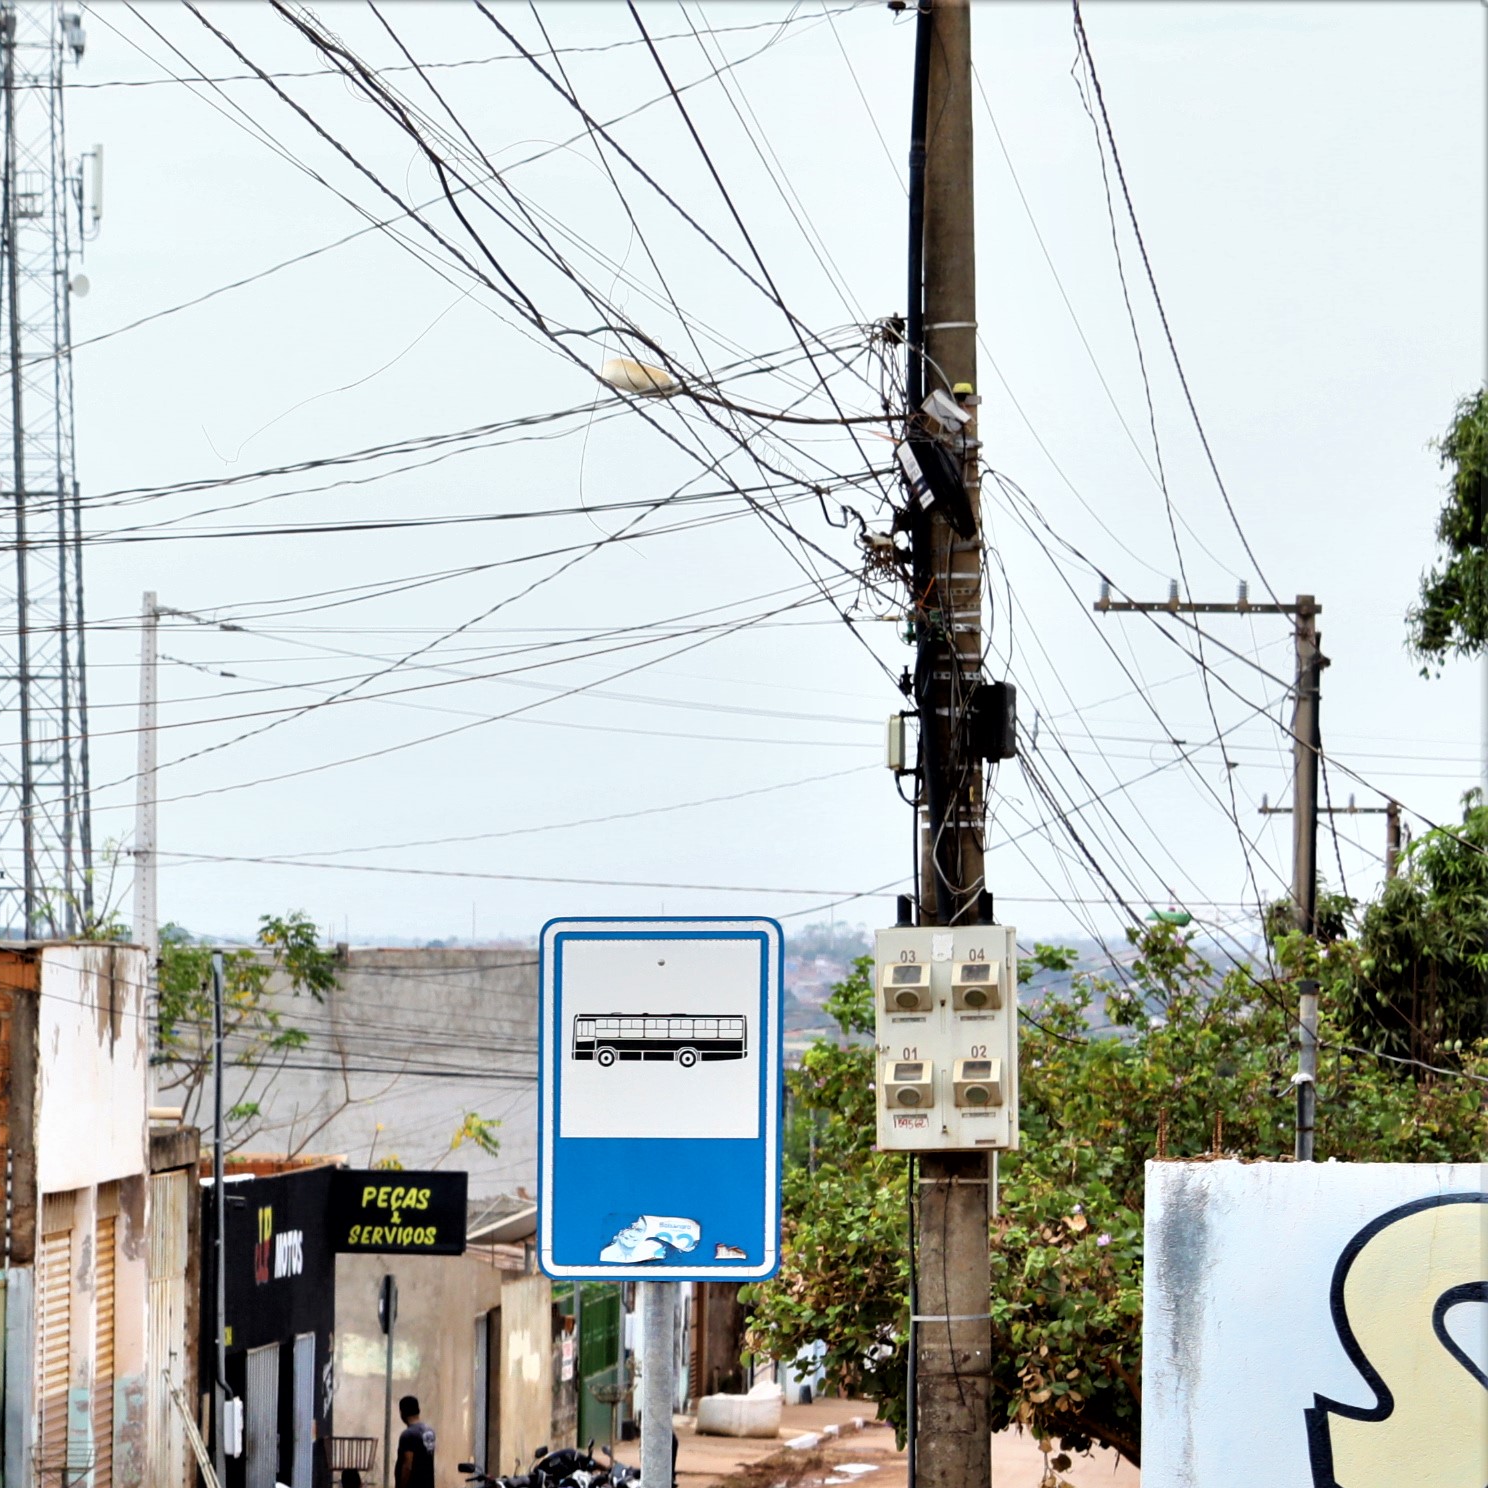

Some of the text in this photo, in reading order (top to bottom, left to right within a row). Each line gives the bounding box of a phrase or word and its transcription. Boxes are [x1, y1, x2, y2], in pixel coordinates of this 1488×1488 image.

[900, 949, 916, 963] 03
[968, 948, 985, 962] 04
[902, 1047, 918, 1061] 01
[971, 1045, 987, 1059] 02
[361, 1186, 432, 1211] PEÇAS
[390, 1210, 402, 1224] &
[347, 1224, 437, 1246] SERVIÇOS
[274, 1229, 304, 1280] MOTOS
